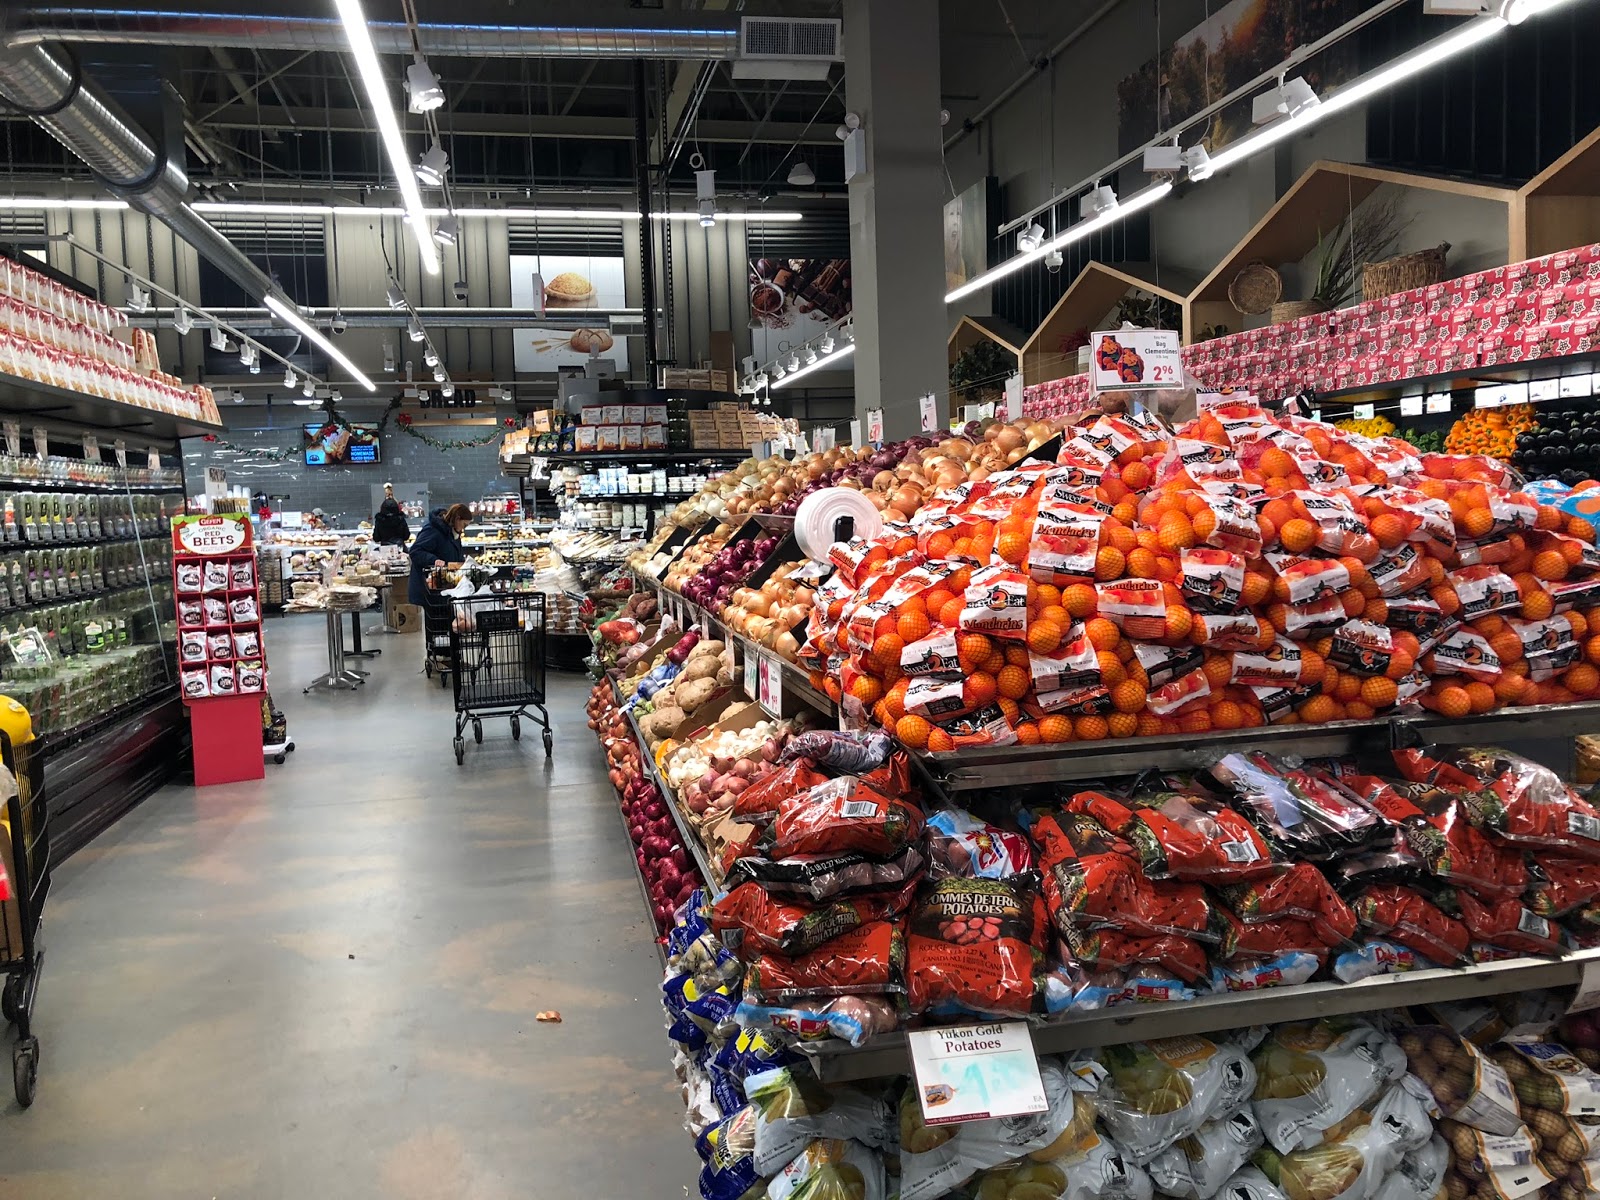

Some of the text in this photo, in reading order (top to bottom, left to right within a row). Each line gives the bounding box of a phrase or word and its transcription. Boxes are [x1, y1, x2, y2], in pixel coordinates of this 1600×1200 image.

[1155, 340, 1166, 348] Bag
[1182, 453, 1212, 465] Sweet
[1084, 475, 1098, 485] Eat
[1056, 488, 1084, 505] Sweet
[1035, 524, 1097, 538] Mandarins
[193, 535, 234, 547] BEETS
[1370, 562, 1397, 577] Sweet
[1184, 575, 1212, 593] Sweet
[1006, 594, 1026, 607] Eat
[1464, 601, 1492, 613] Sweet
[1502, 592, 1517, 604] Eat
[963, 617, 1024, 631] Mandarins
[1525, 640, 1547, 651] Sweet
[1282, 648, 1300, 661] Eat
[1437, 646, 1467, 660] Sweet
[1482, 653, 1501, 667] Eat
[903, 662, 931, 676] Sweet
[942, 657, 959, 671] Eat
[942, 903, 1004, 915] POTATOES
[918, 944, 948, 952] ROUGE
[769, 1014, 799, 1033] Dole
[937, 1024, 1003, 1040] Yukon Gold
[945, 1039, 1002, 1053] Potatoes
